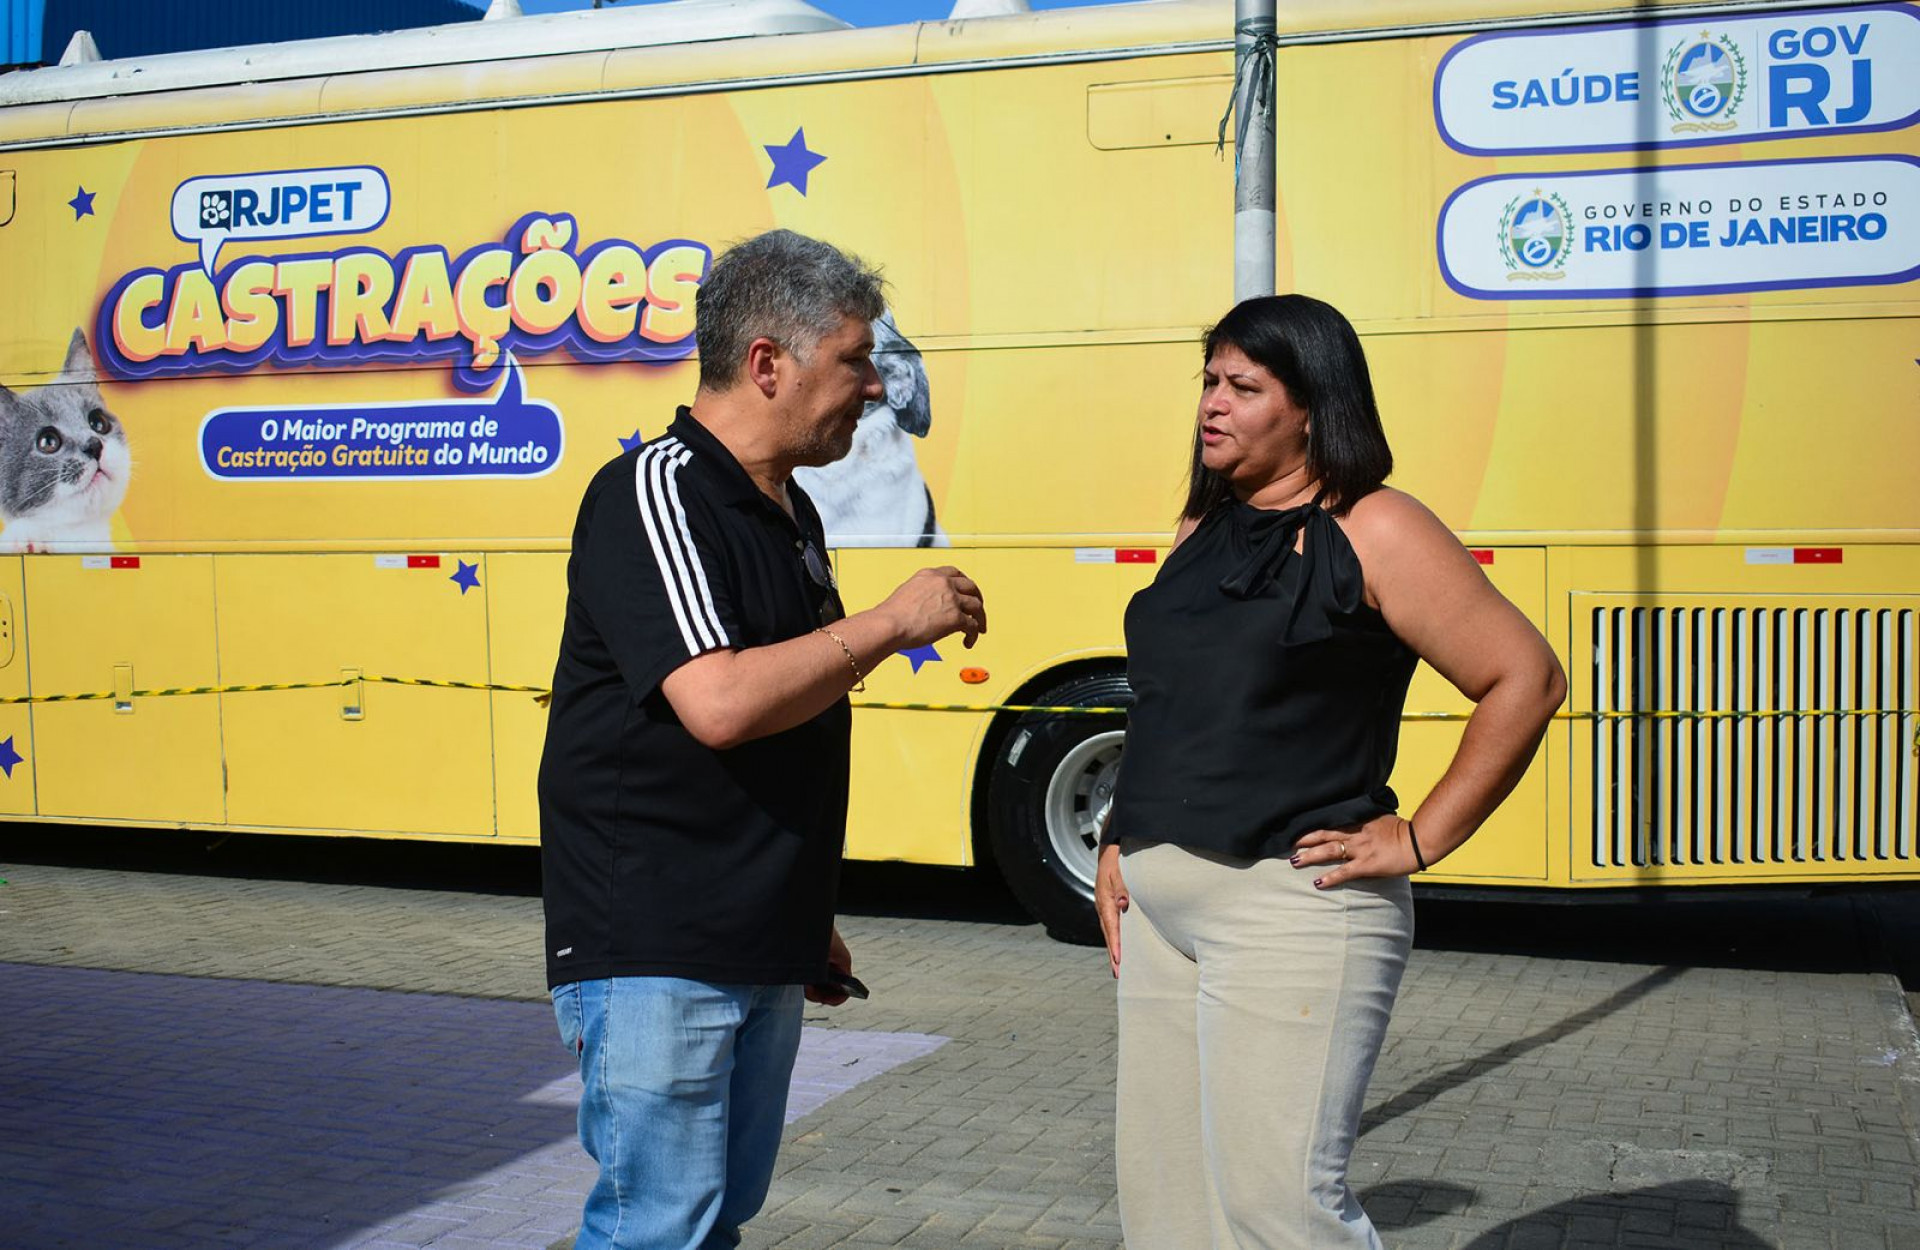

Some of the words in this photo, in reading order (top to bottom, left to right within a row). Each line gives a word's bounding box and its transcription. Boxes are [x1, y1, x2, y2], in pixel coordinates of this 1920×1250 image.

[1768, 23, 1871, 60] GOV
[1491, 68, 1640, 110] SAÚDE
[1769, 59, 1872, 128] RJ
[233, 181, 362, 228] RJPET
[1584, 200, 1713, 220] GOVERNO
[1729, 197, 1763, 213] DO
[1780, 191, 1888, 211] ESTADO
[1584, 222, 1652, 253] RIO
[1660, 221, 1711, 249] DE
[1719, 212, 1888, 248] JANEIRO
[261, 419, 279, 442] O
[282, 418, 347, 442] Maior
[351, 418, 465, 445] Programa
[469, 415, 499, 438] de
[217, 443, 328, 473] Castração
[331, 444, 430, 468] Gratuita
[433, 442, 463, 466] do
[467, 441, 548, 465] Mundo
